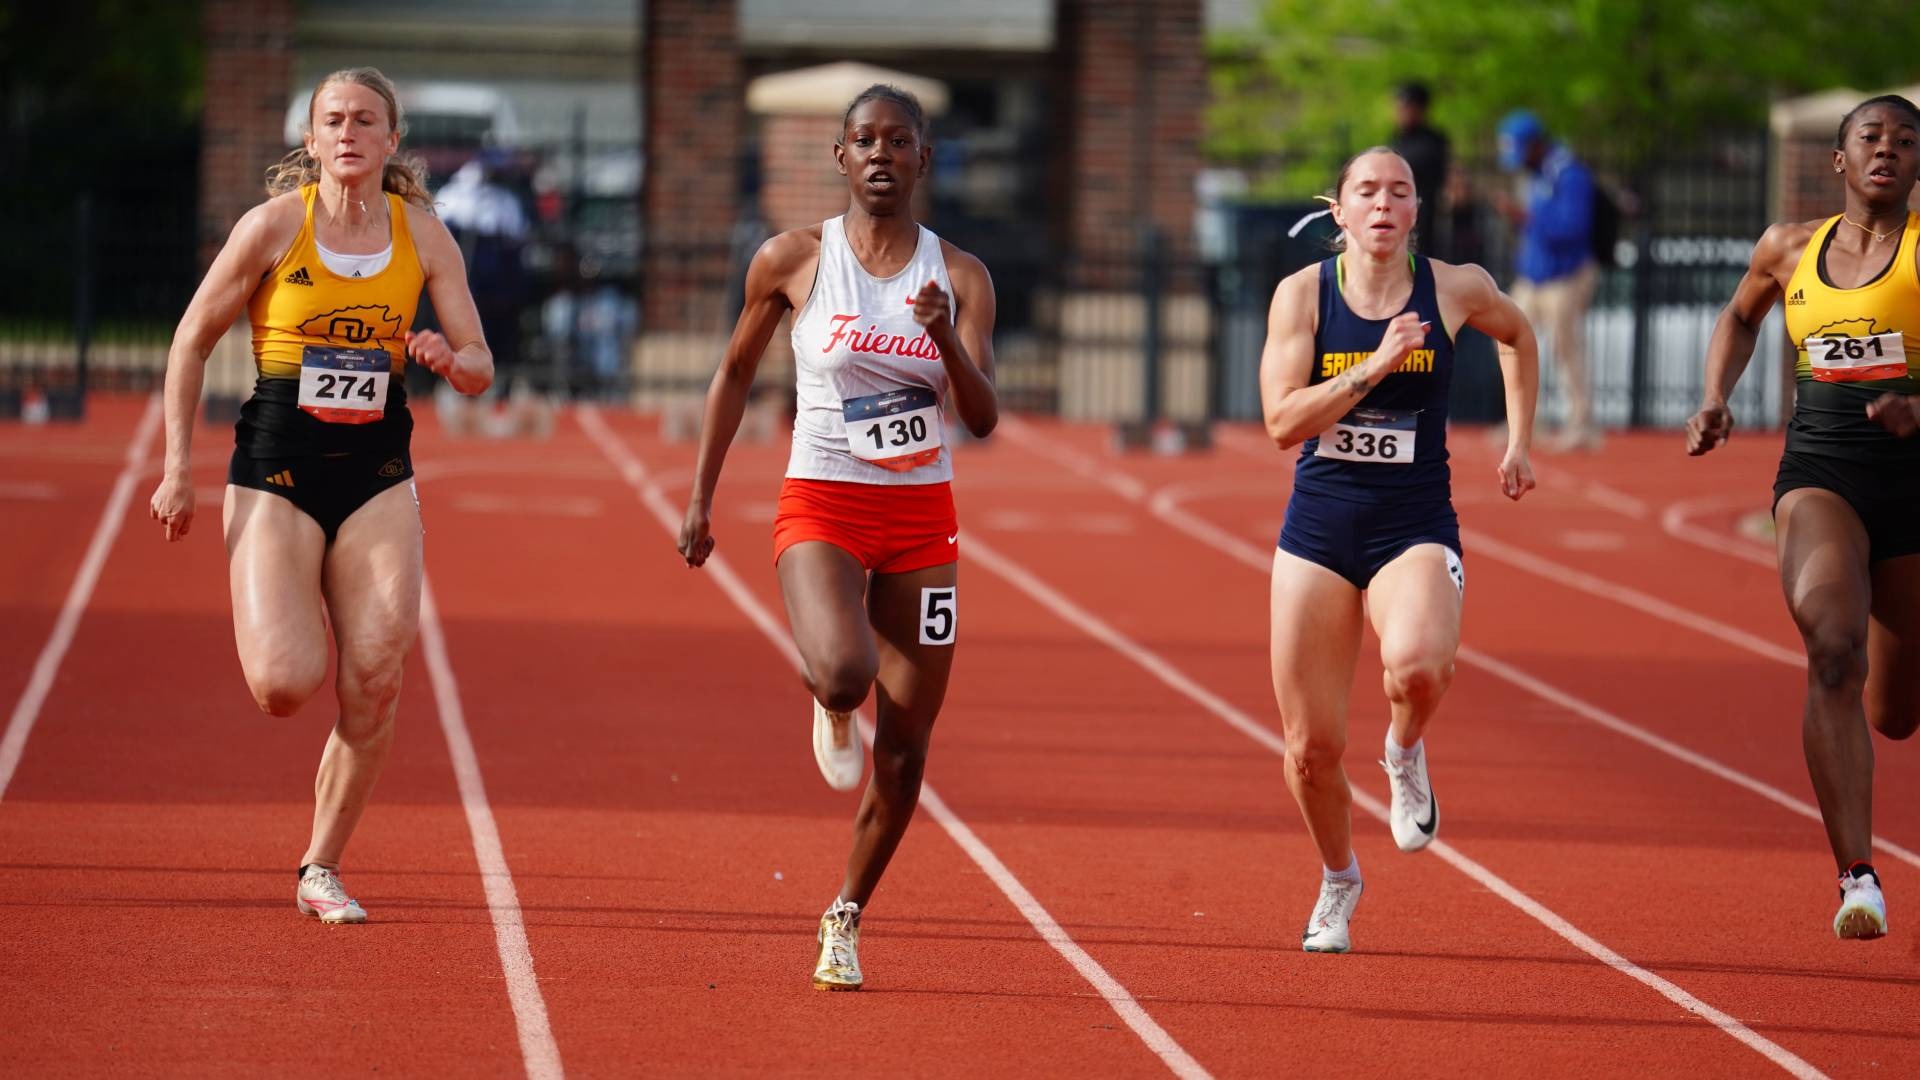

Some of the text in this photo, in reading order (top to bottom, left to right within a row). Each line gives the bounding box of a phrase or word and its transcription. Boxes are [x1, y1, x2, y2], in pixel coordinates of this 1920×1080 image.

[285, 277, 314, 287] adidas
[822, 314, 942, 361] Friends
[1822, 337, 1884, 360] 261
[315, 374, 376, 401] 274
[866, 415, 927, 450] 130
[1335, 430, 1397, 459] 336
[926, 592, 953, 641] 5
